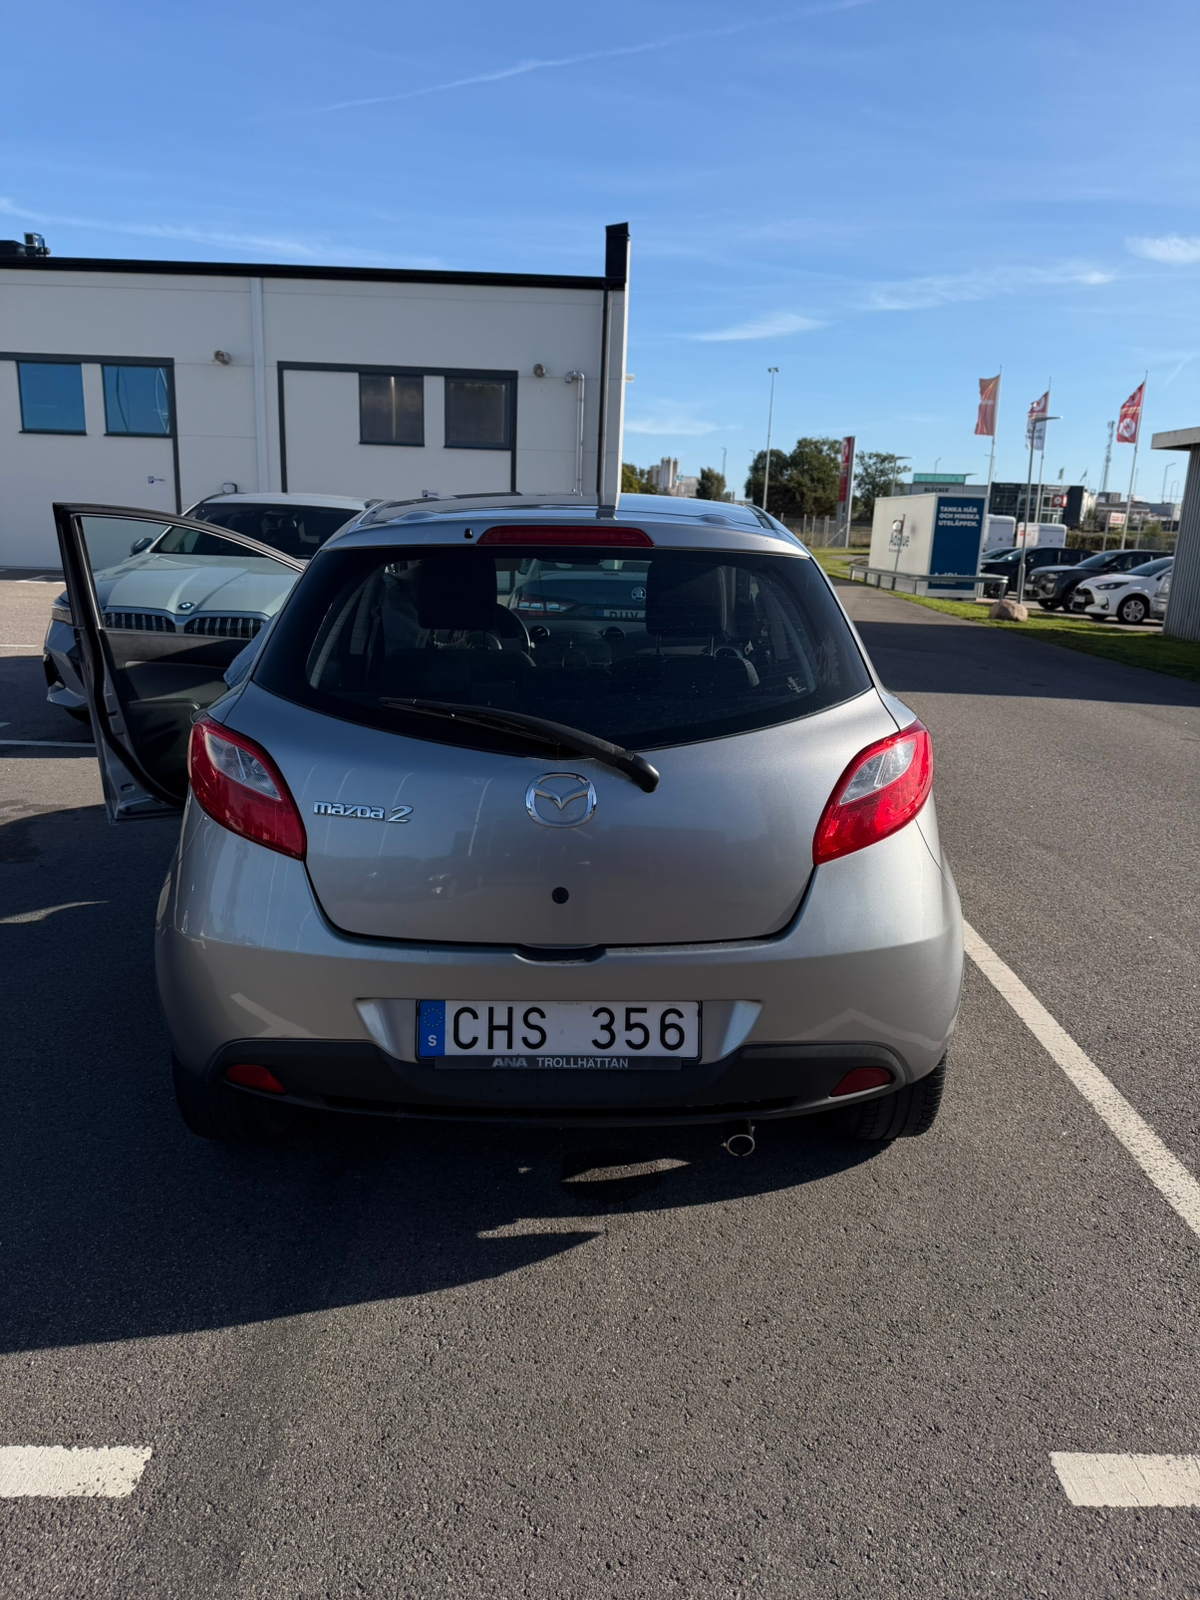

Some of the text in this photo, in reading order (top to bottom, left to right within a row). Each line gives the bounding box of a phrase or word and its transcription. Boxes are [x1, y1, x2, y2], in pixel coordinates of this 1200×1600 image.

[312, 801, 414, 824] mazda 2
[453, 1006, 686, 1050] CHS 356
[427, 1035, 437, 1047] S
[492, 1056, 629, 1069] ANA TROLLHÄTTAN
